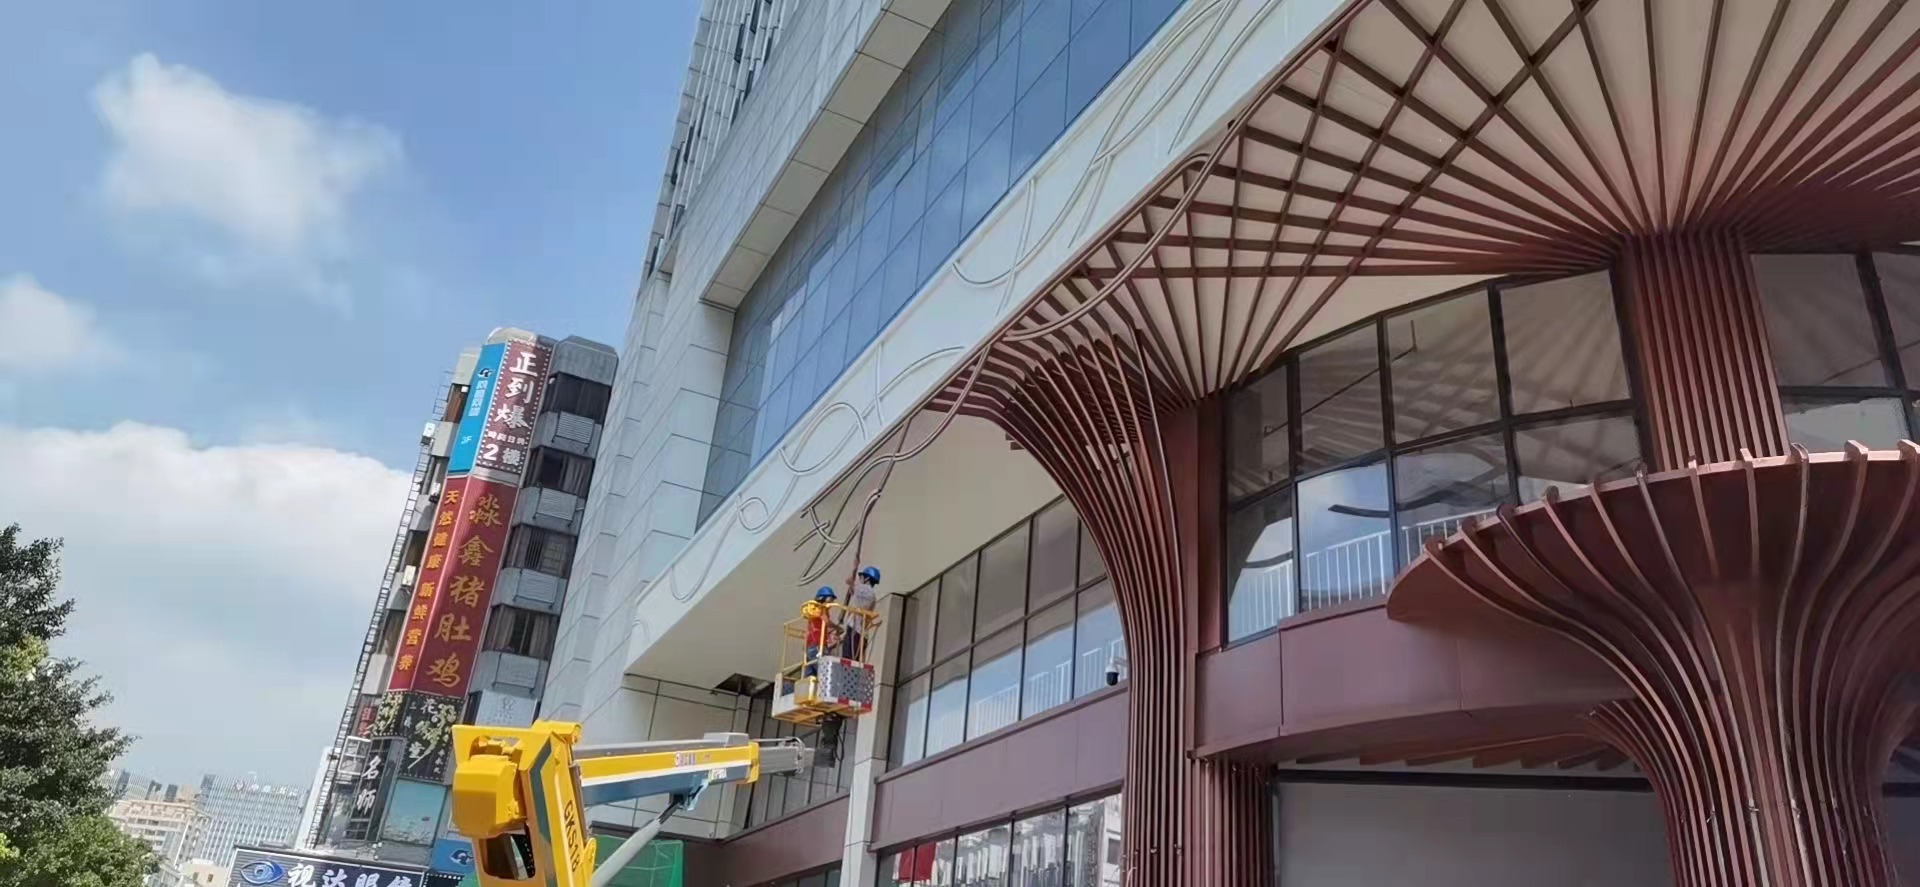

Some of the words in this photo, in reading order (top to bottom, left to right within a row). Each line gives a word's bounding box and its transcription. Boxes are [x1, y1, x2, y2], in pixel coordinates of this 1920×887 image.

[426, 494, 502, 688] 淼鑫猪肚鸡
[564, 800, 580, 872] GKS18
